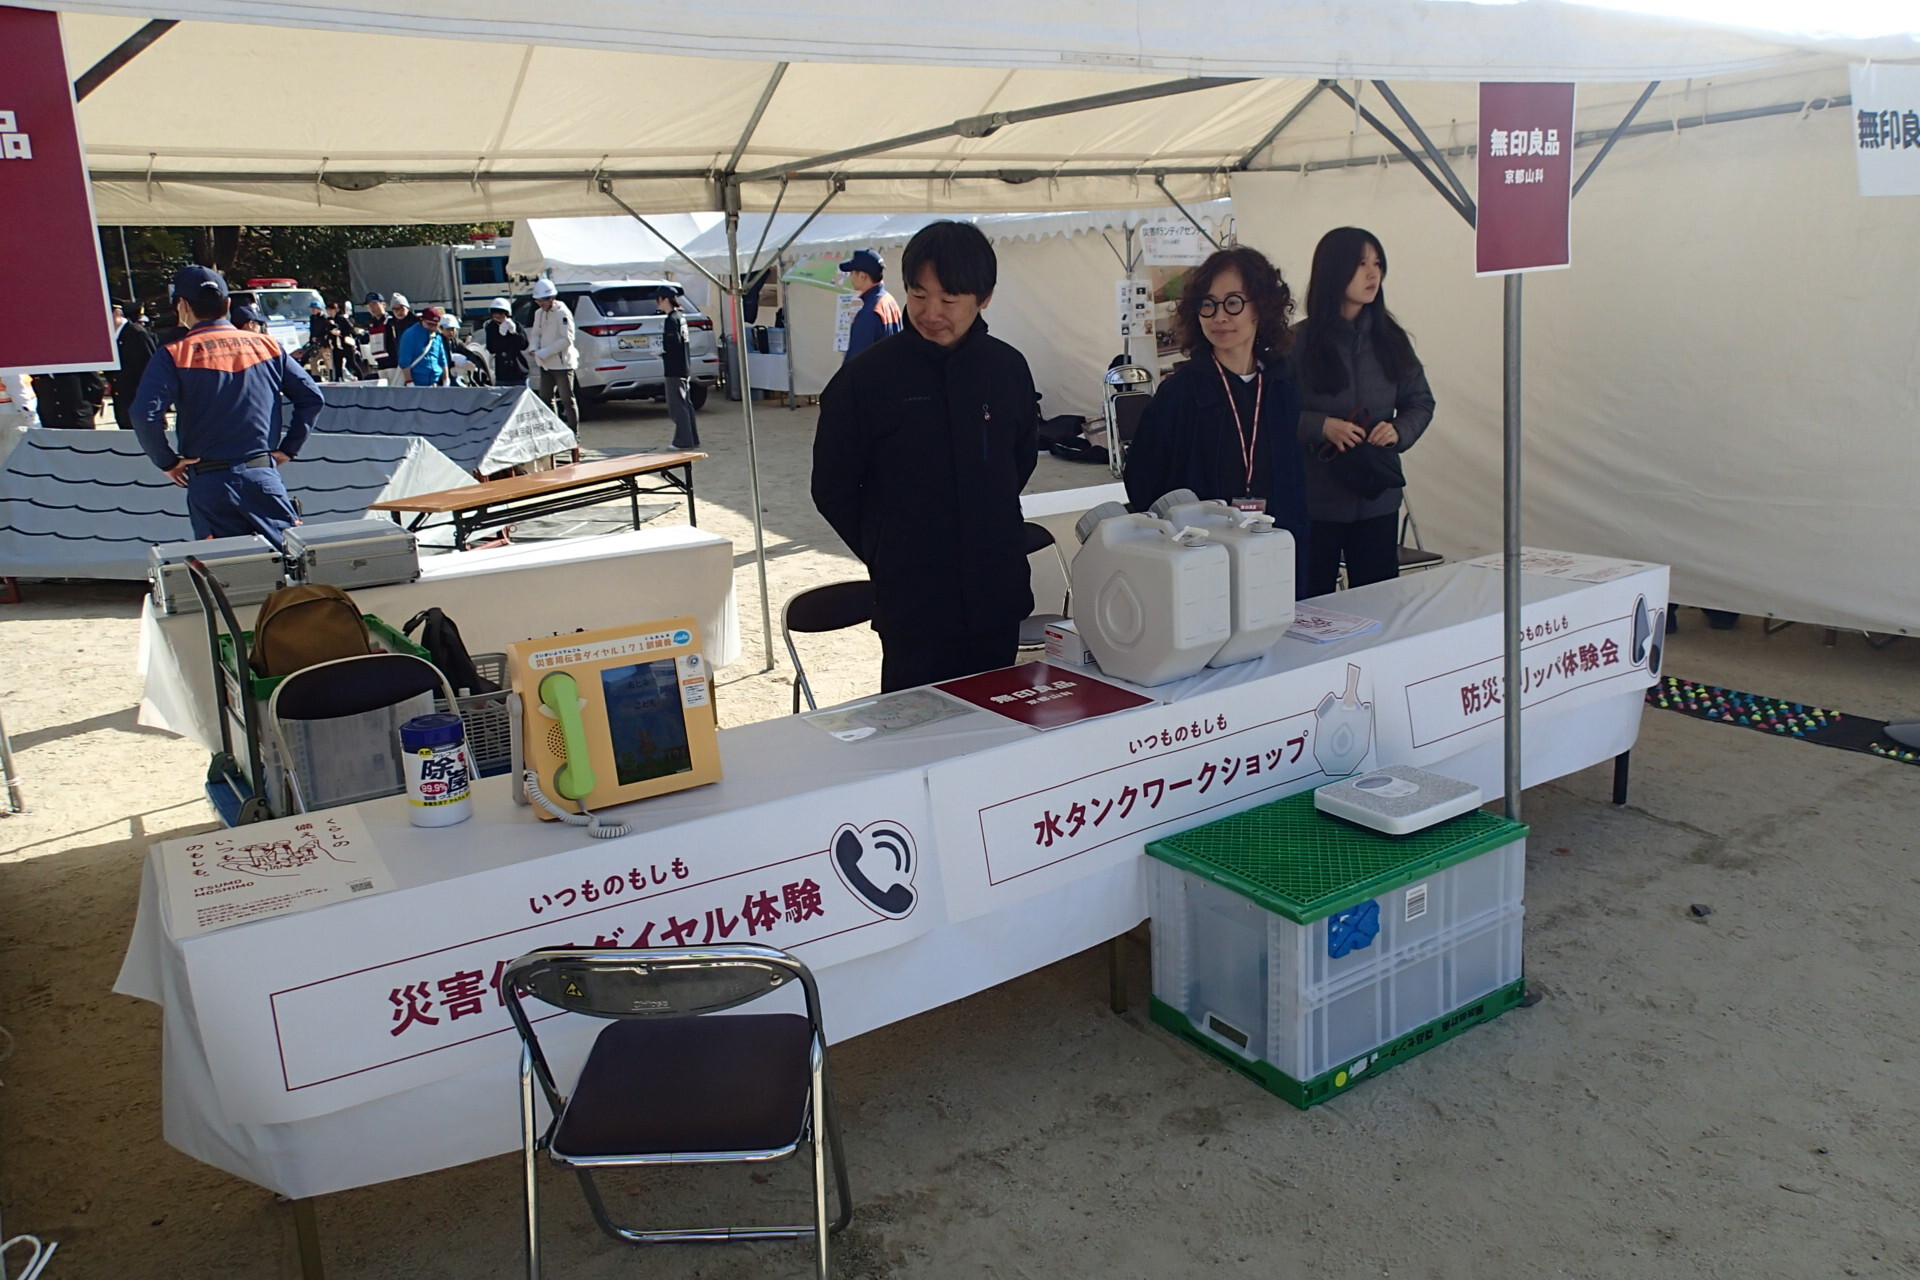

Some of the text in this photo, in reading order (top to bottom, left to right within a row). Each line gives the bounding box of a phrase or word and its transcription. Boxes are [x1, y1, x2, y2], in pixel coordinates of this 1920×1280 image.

[1490, 128, 1560, 157] 無印良品
[1504, 168, 1544, 184] 京都山科
[1142, 226, 1207, 237] 災害ボランティアセン
[1460, 638, 1620, 716] 防災リッパ体験会
[990, 680, 1078, 704] 無印良品
[1129, 713, 1228, 754] いつものもしも
[421, 757, 468, 793] 除菌
[421, 783, 448, 794] 99.9%
[1033, 729, 1309, 847] 水タンクワークショップ
[294, 823, 318, 839] 備え。
[325, 818, 351, 848] くらしの
[185, 844, 211, 878] のもしも。
[214, 839, 237, 862] いつも
[193, 879, 243, 894] ITSUMO
[194, 881, 255, 898] MOSHIMO
[529, 856, 691, 915] いつものもしも
[388, 877, 825, 1037] 災害ダイヤル体験
